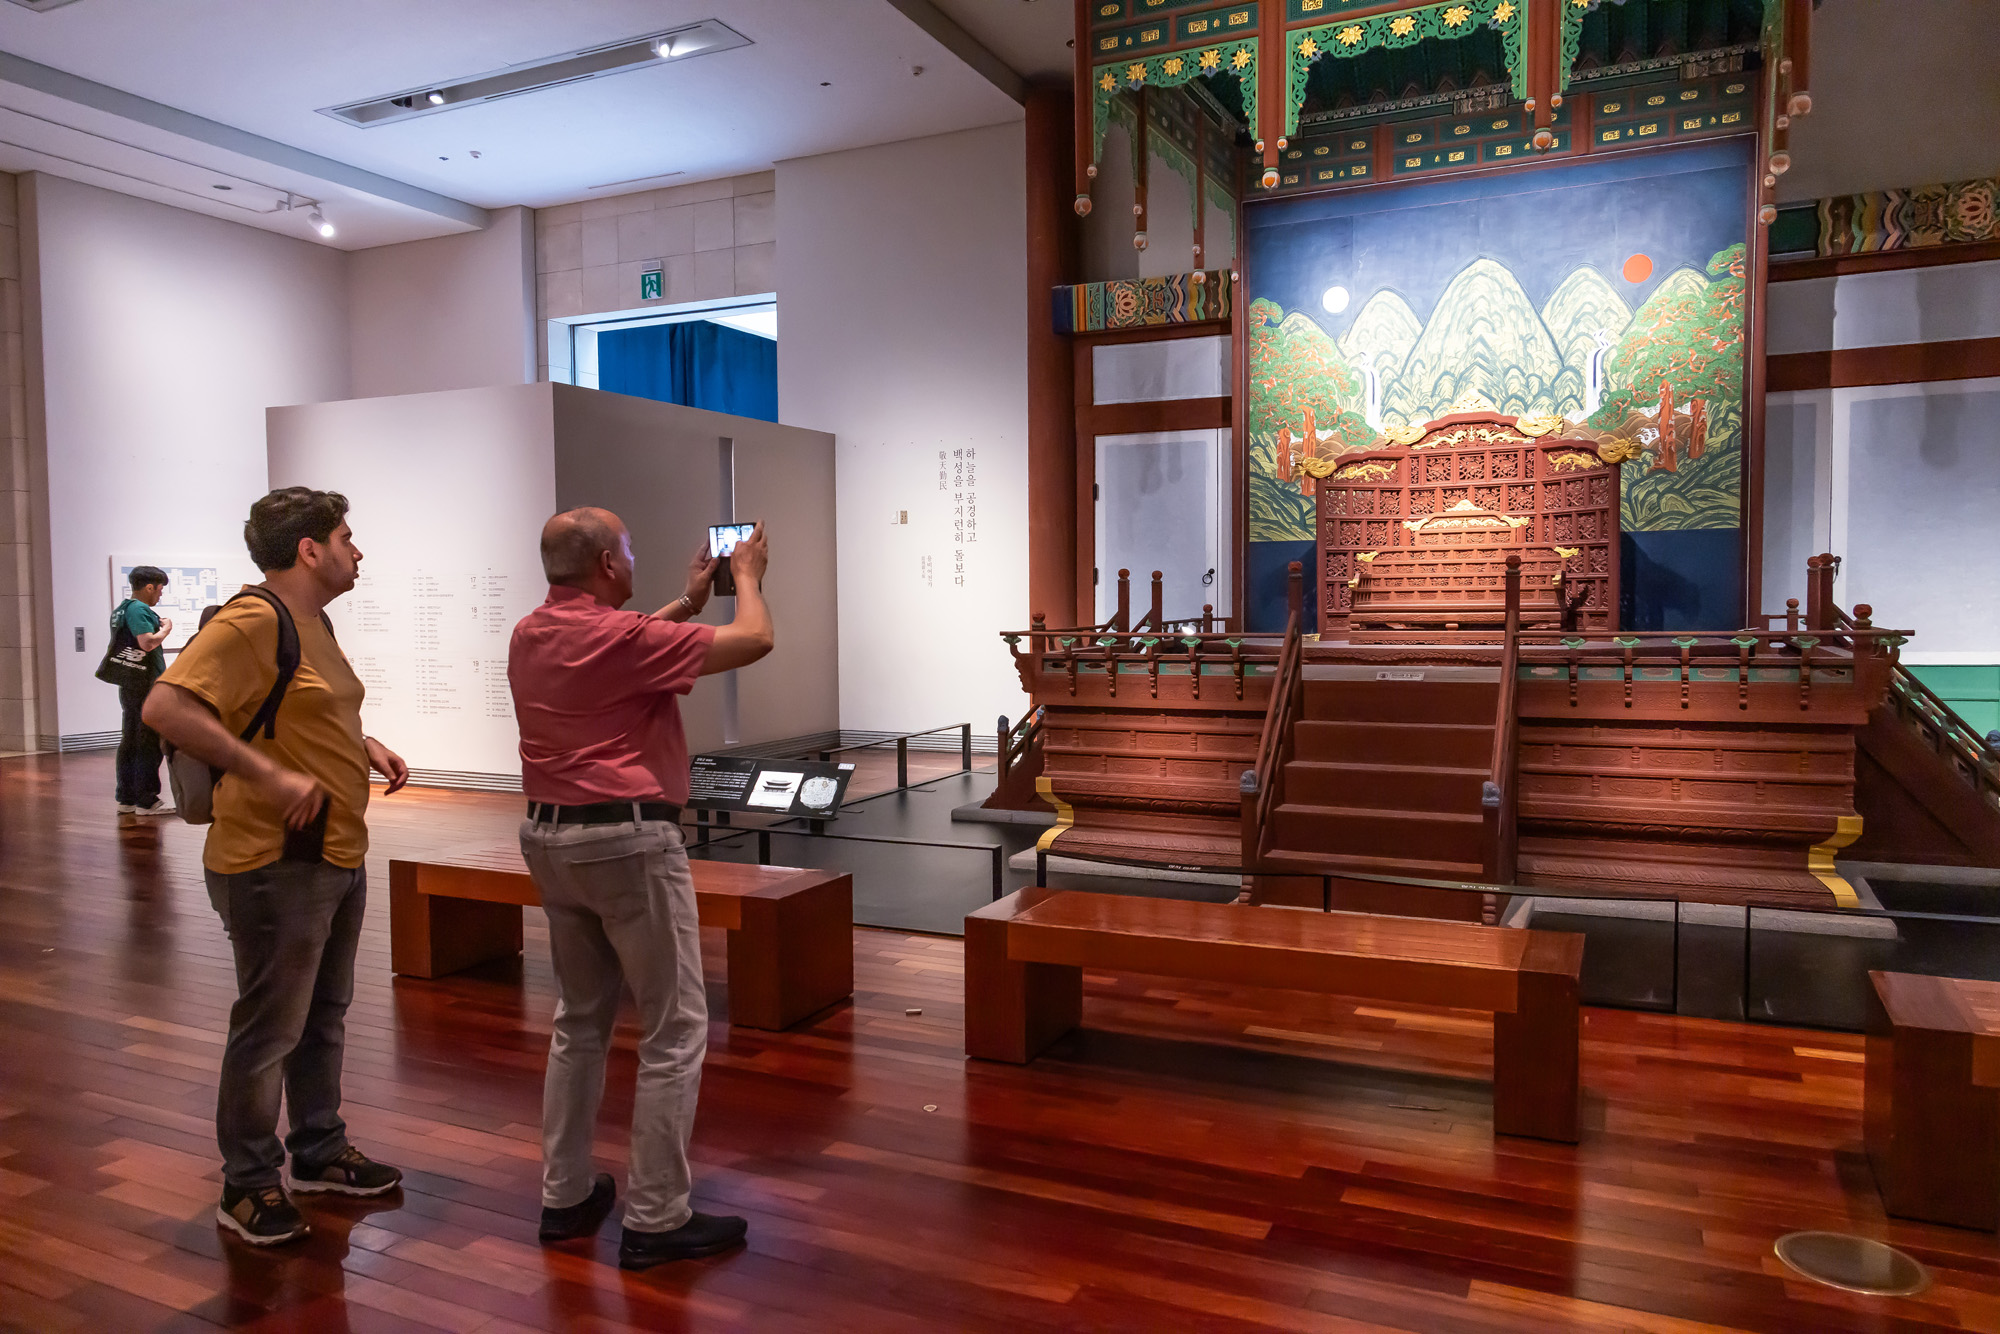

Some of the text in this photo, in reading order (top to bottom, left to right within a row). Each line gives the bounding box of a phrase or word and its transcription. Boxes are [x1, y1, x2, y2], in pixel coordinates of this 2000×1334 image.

[953, 448, 965, 588] 백성을 부지런히 돌보다
[966, 448, 977, 543] 하늘을 공경하고
[122, 660, 147, 670] balance
